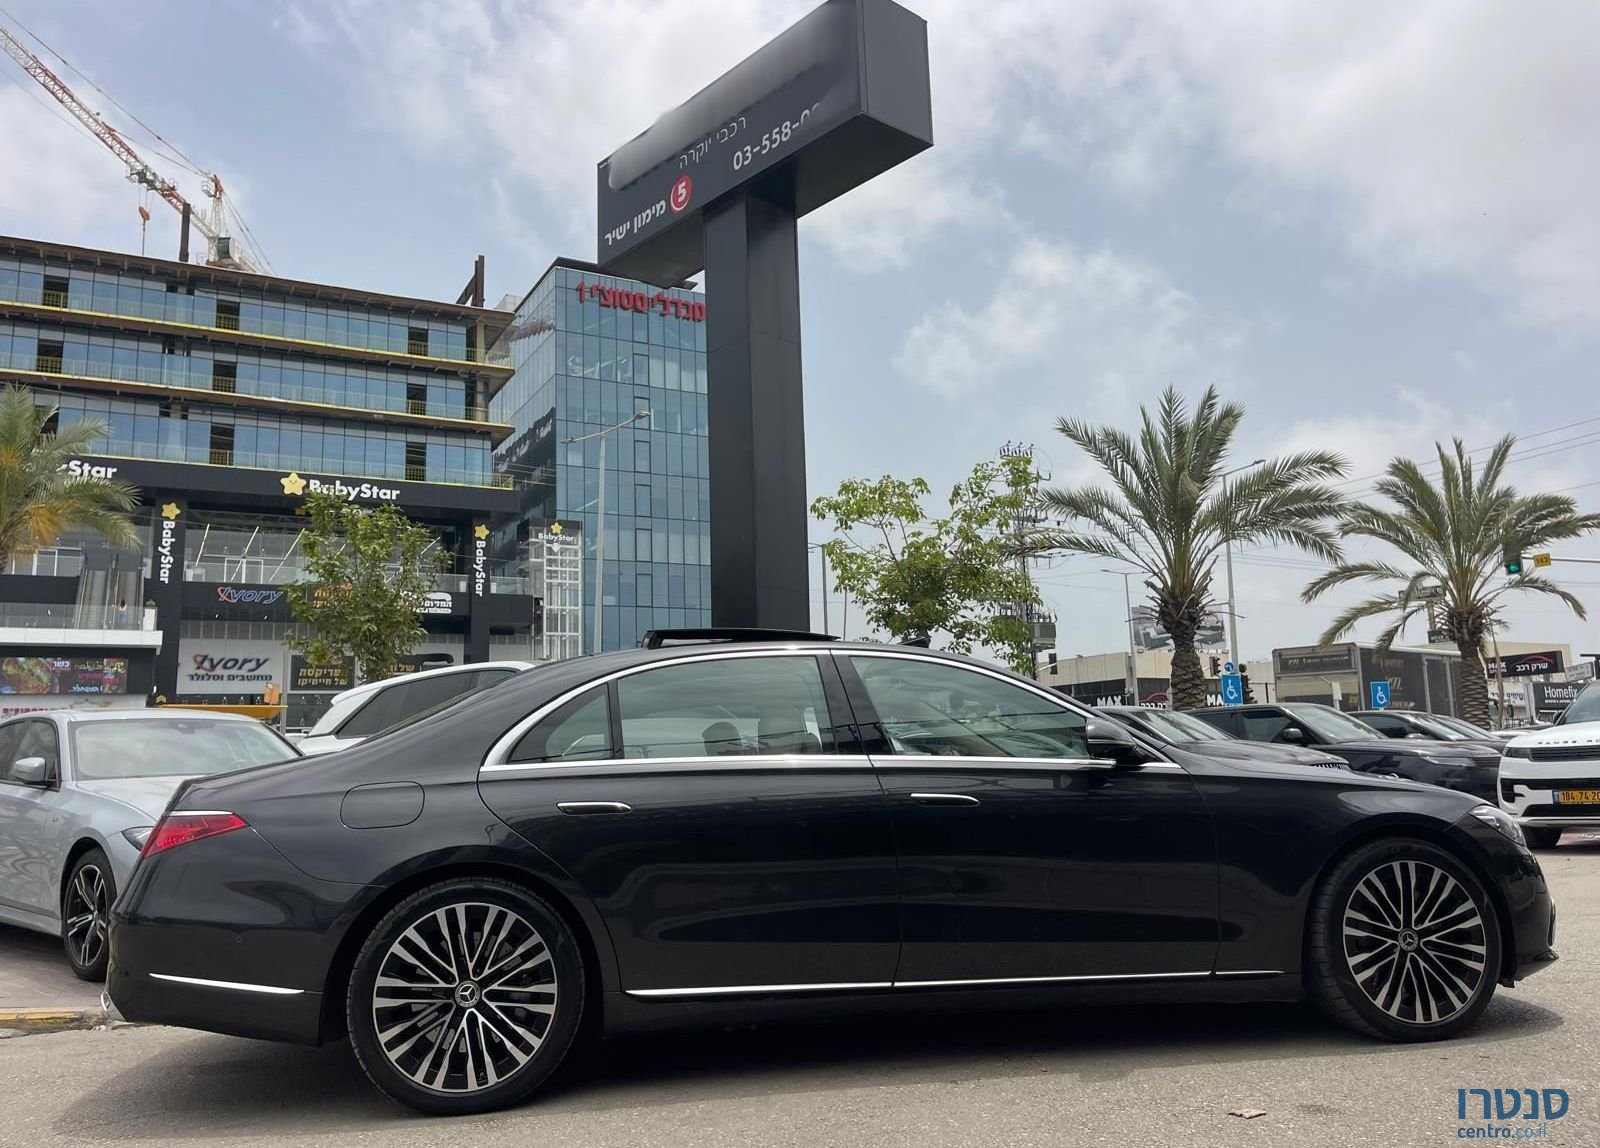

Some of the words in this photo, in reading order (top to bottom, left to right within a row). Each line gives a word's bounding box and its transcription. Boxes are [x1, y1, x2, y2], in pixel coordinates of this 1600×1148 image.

[716, 116, 746, 144] רכבי
[679, 138, 712, 169] יוקרה
[634, 199, 666, 234] מימון
[604, 220, 631, 246] ישיר
[309, 479, 400, 501] BabyStar
[538, 532, 575, 542] BabyStar
[158, 520, 176, 585] BabyStar
[472, 540, 487, 597] BabyStar
[216, 586, 284, 605] Ivory
[192, 654, 270, 673] Ivory
[1515, 664, 1530, 672] רכב
[1531, 662, 1548, 672] שרק
[187, 672, 225, 682] וסלולר
[227, 673, 273, 682] מחשבים
[1206, 693, 1225, 706] MA
